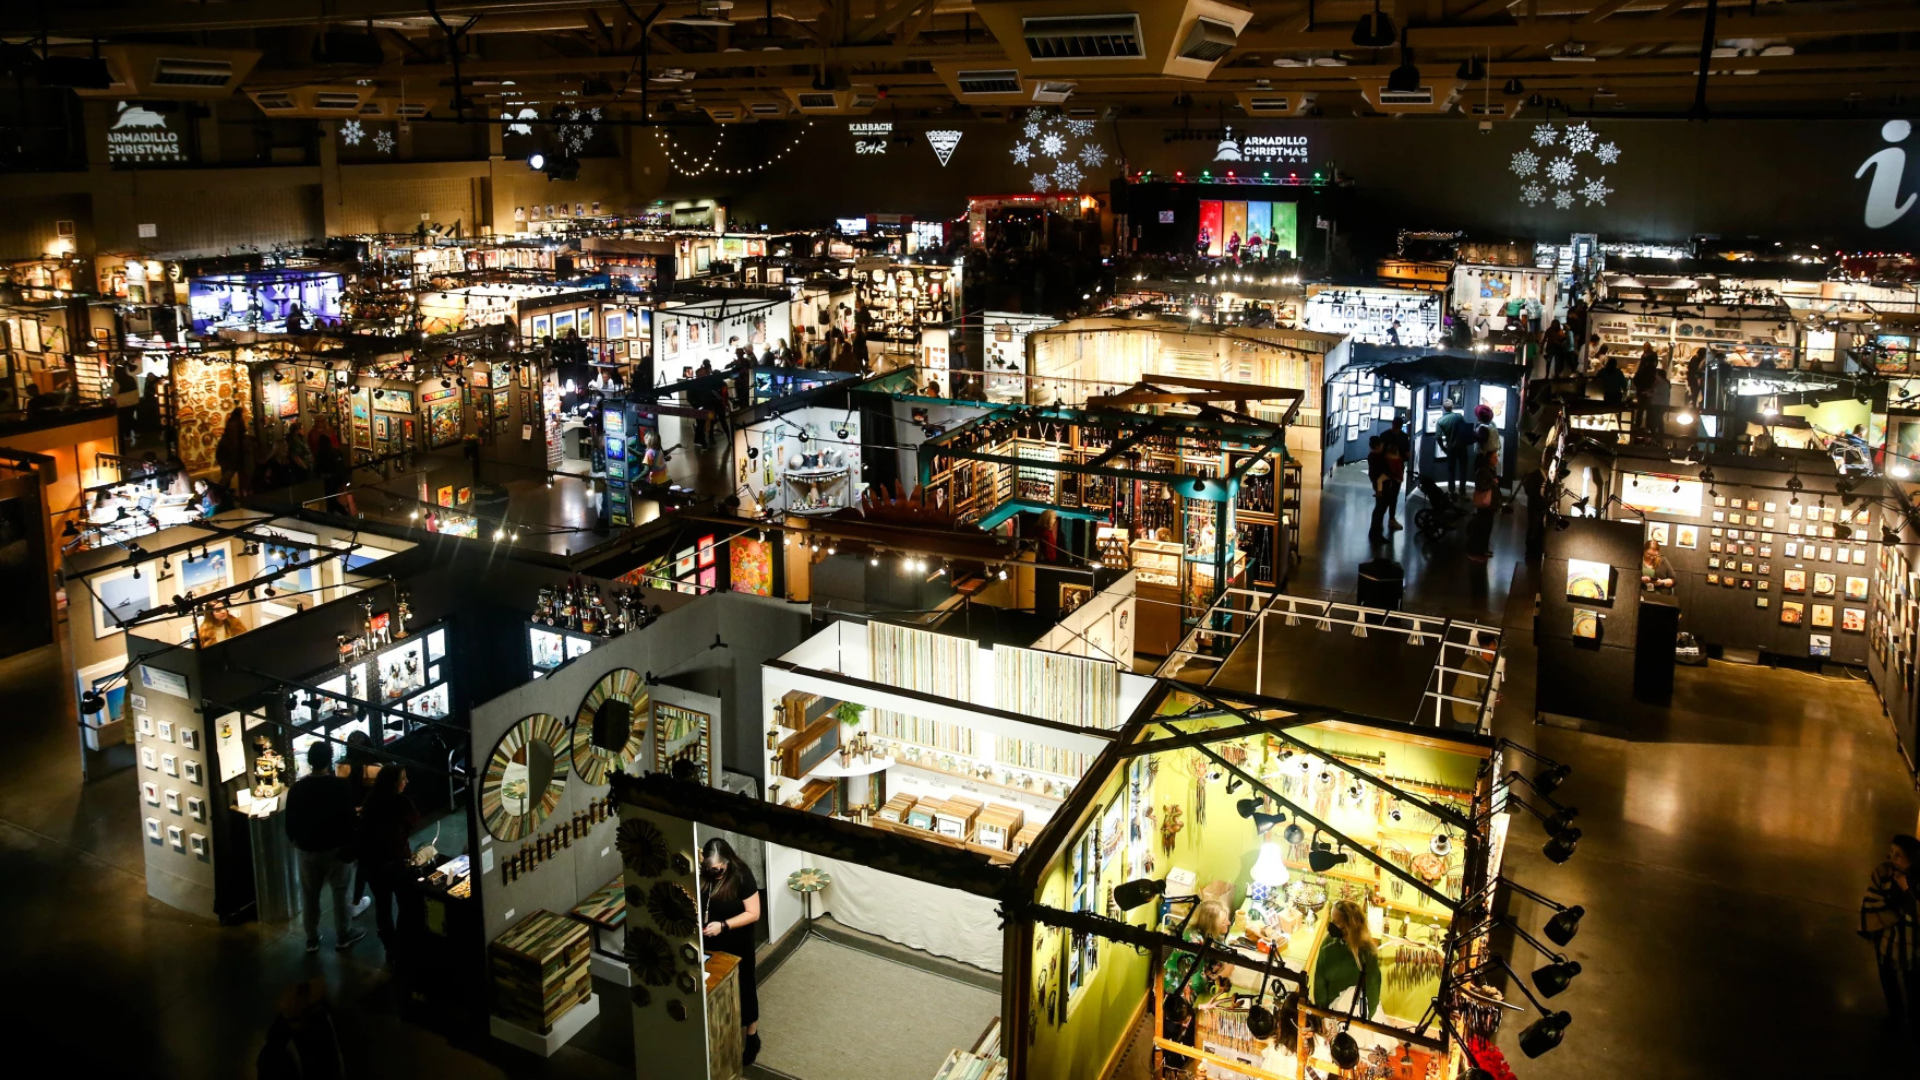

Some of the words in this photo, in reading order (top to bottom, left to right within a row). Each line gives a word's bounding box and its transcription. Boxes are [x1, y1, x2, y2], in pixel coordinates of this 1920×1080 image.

[849, 123, 893, 131] KARBACH
[107, 132, 178, 143] ARMADILLO
[1244, 136, 1308, 146] ARMADILLO
[108, 144, 179, 154] CHRISTMAS
[855, 140, 888, 154] BAR
[1244, 147, 1308, 156] CHRISTMAS
